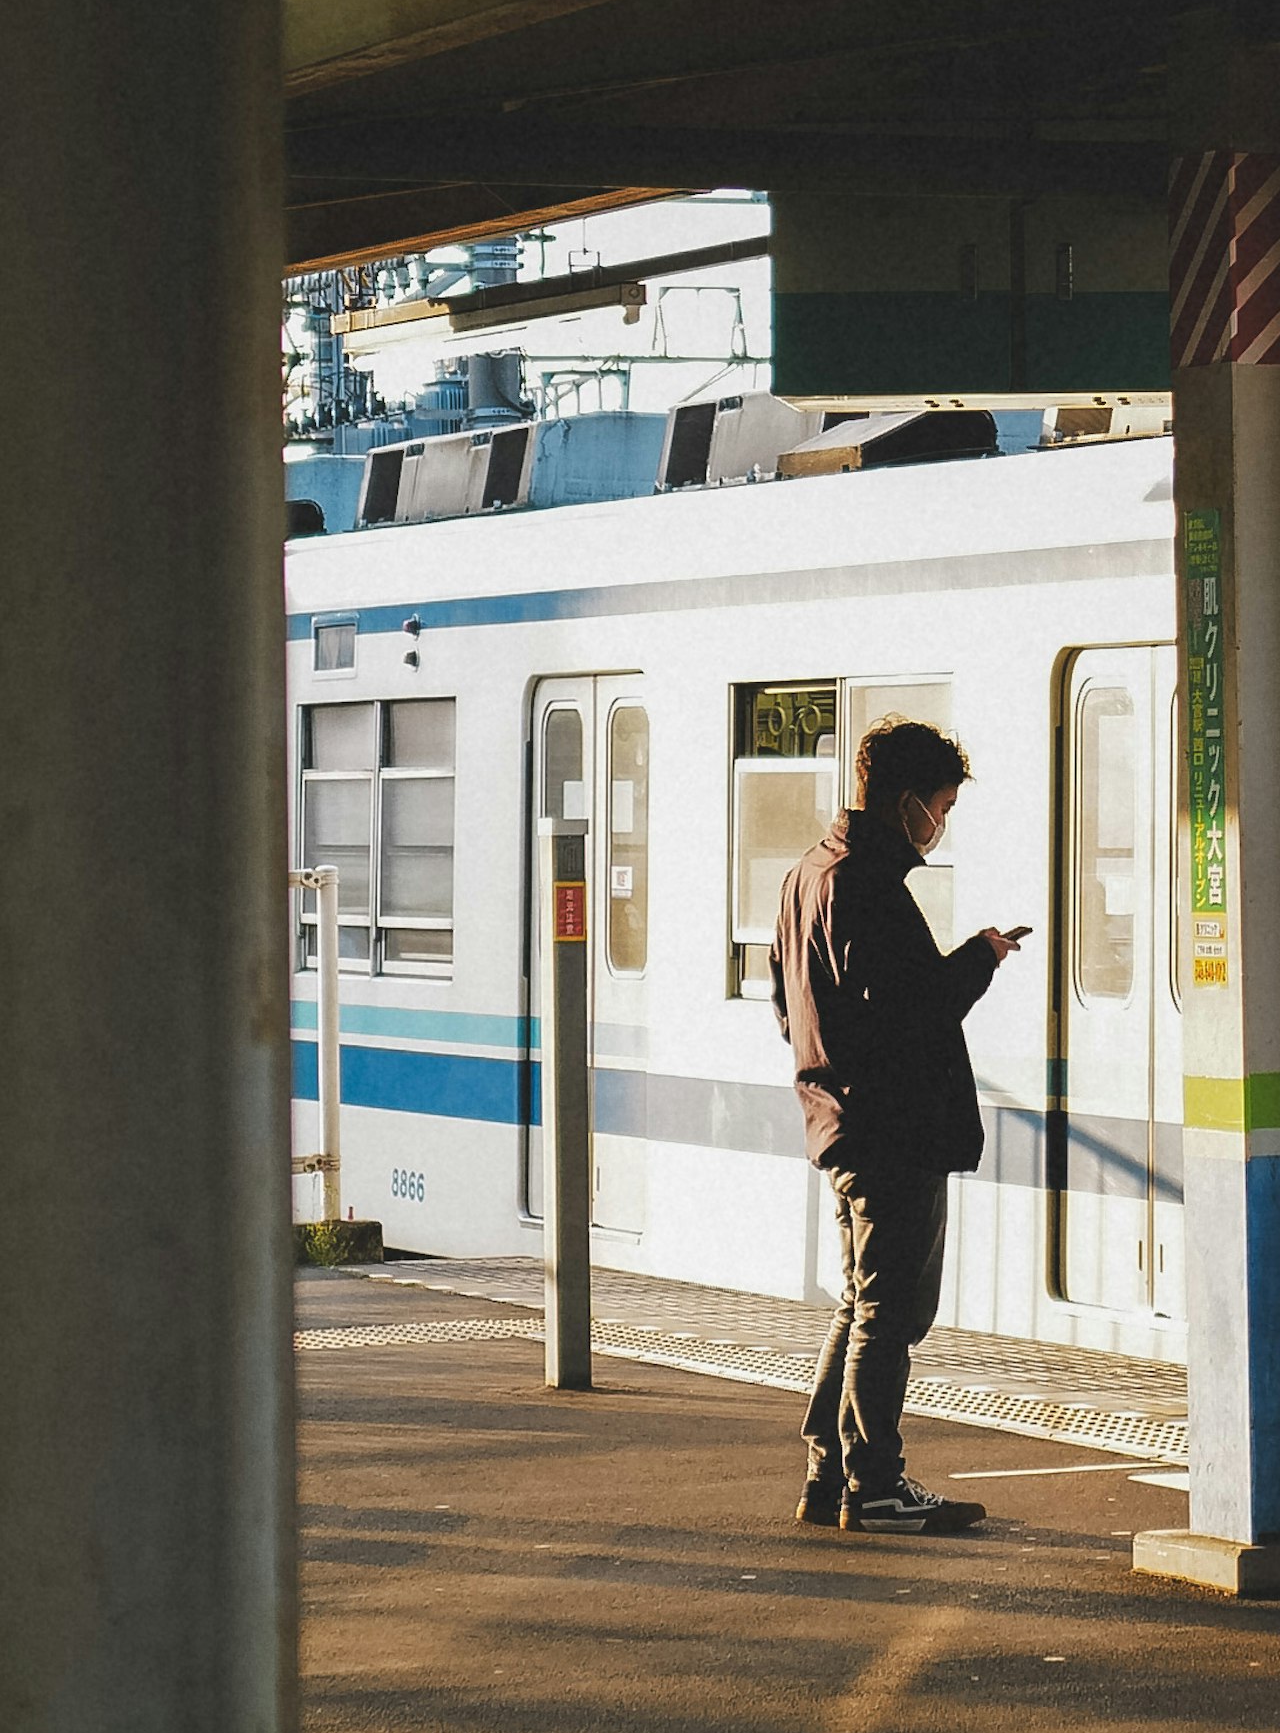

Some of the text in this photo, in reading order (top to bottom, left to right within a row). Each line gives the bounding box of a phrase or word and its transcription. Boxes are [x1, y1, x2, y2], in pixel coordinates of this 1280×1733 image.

[1203, 577, 1223, 906] 肌クリニック大宮
[391, 1168, 425, 1203] 8866
